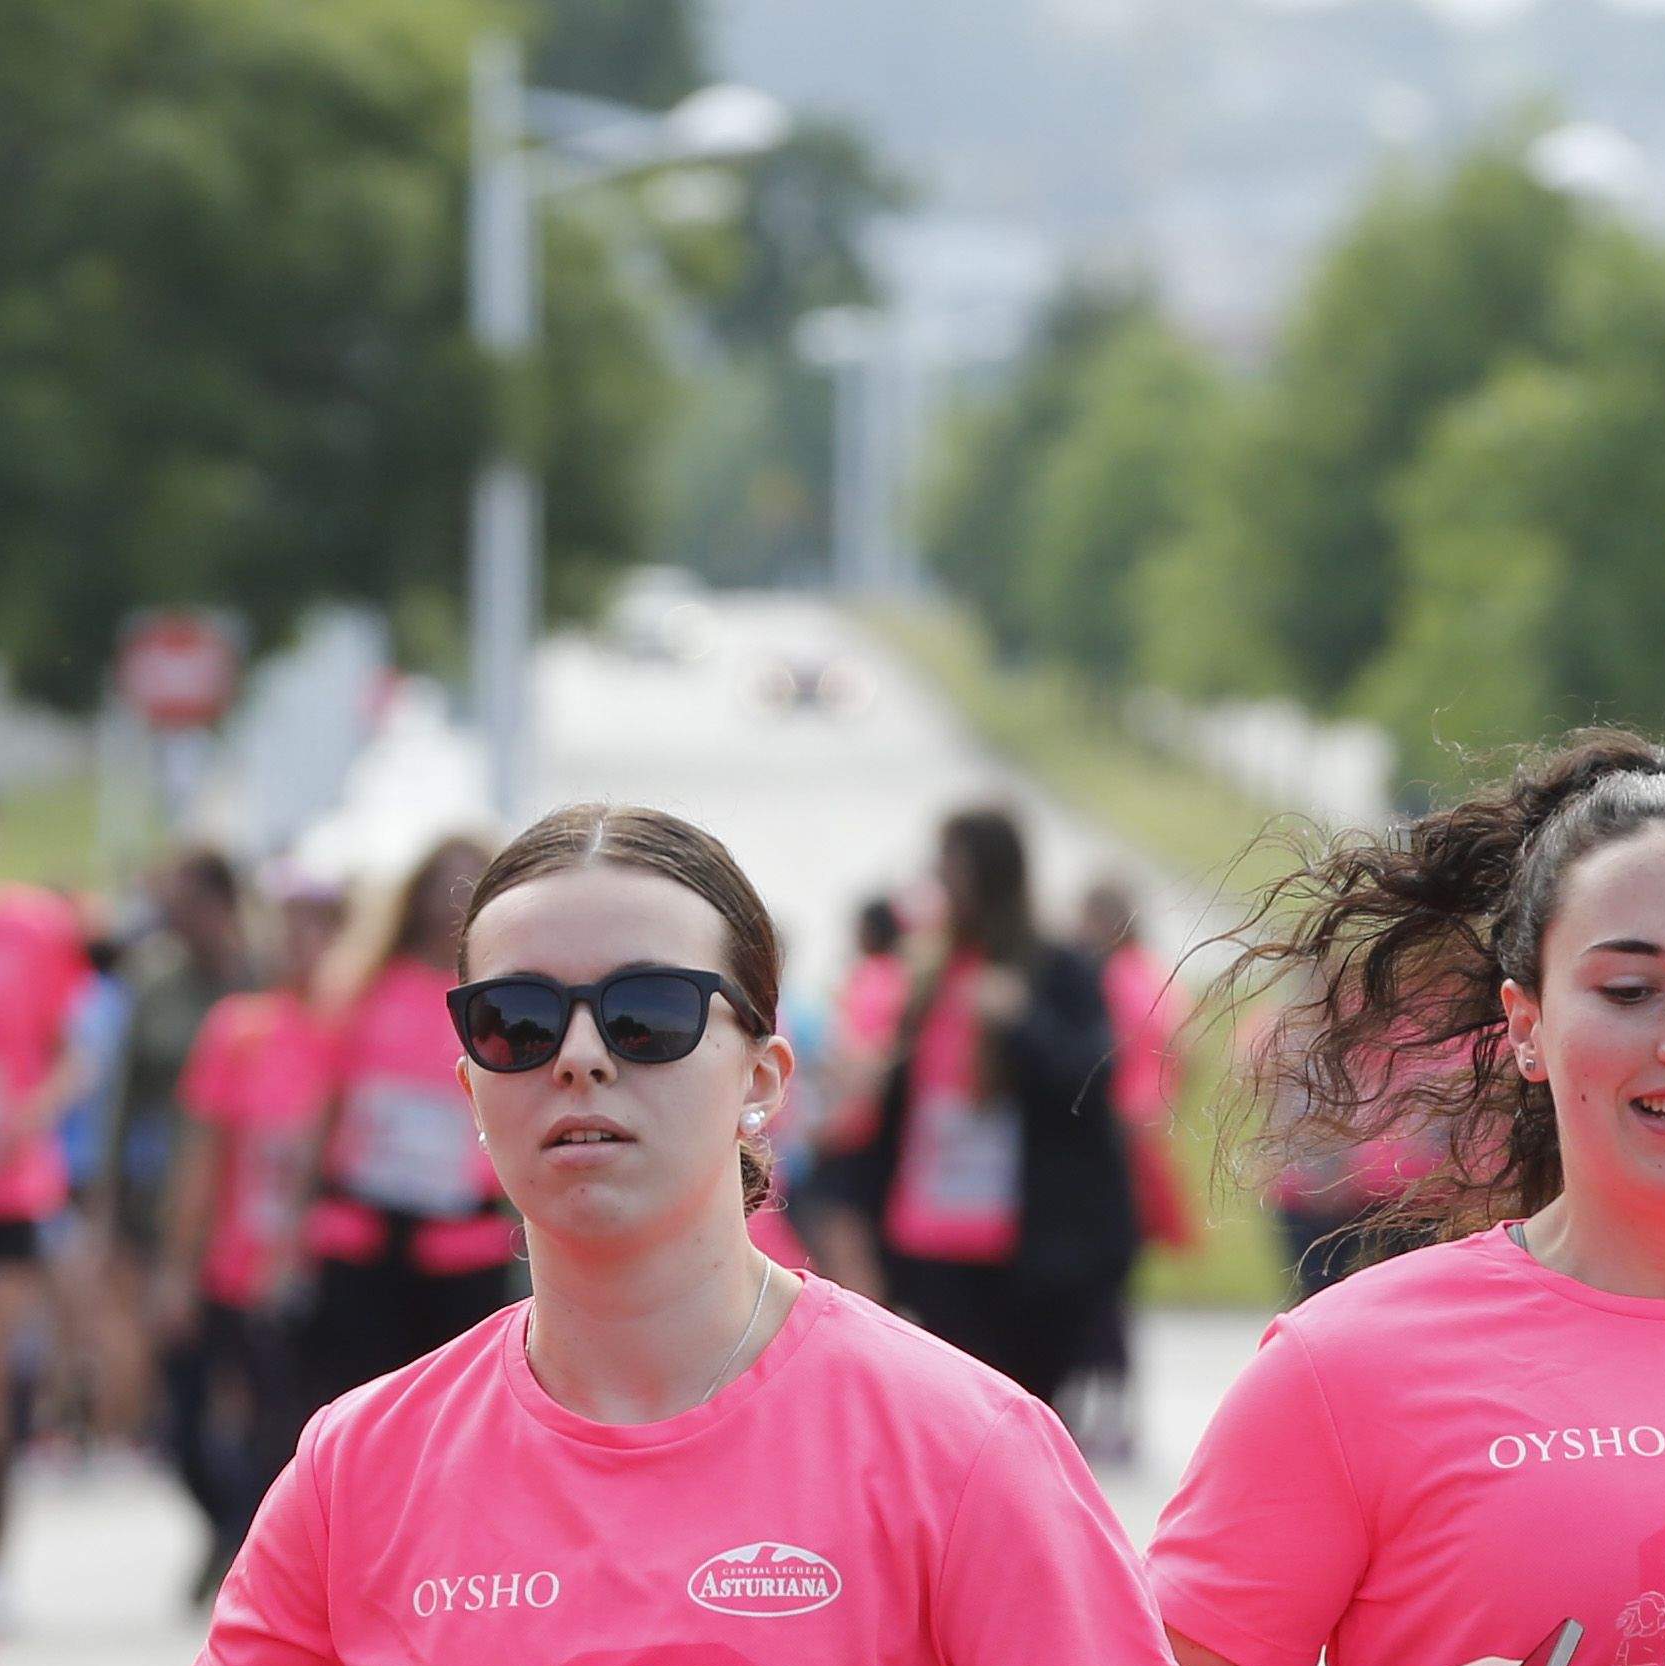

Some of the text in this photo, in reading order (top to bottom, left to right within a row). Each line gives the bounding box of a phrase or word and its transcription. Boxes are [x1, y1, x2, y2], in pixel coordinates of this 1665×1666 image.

[1489, 1425, 1665, 1468] OYSHO
[698, 1571, 829, 1598] ASTURIANA
[722, 1567, 771, 1576] CENTRAL
[413, 1571, 559, 1617] OYSHO
